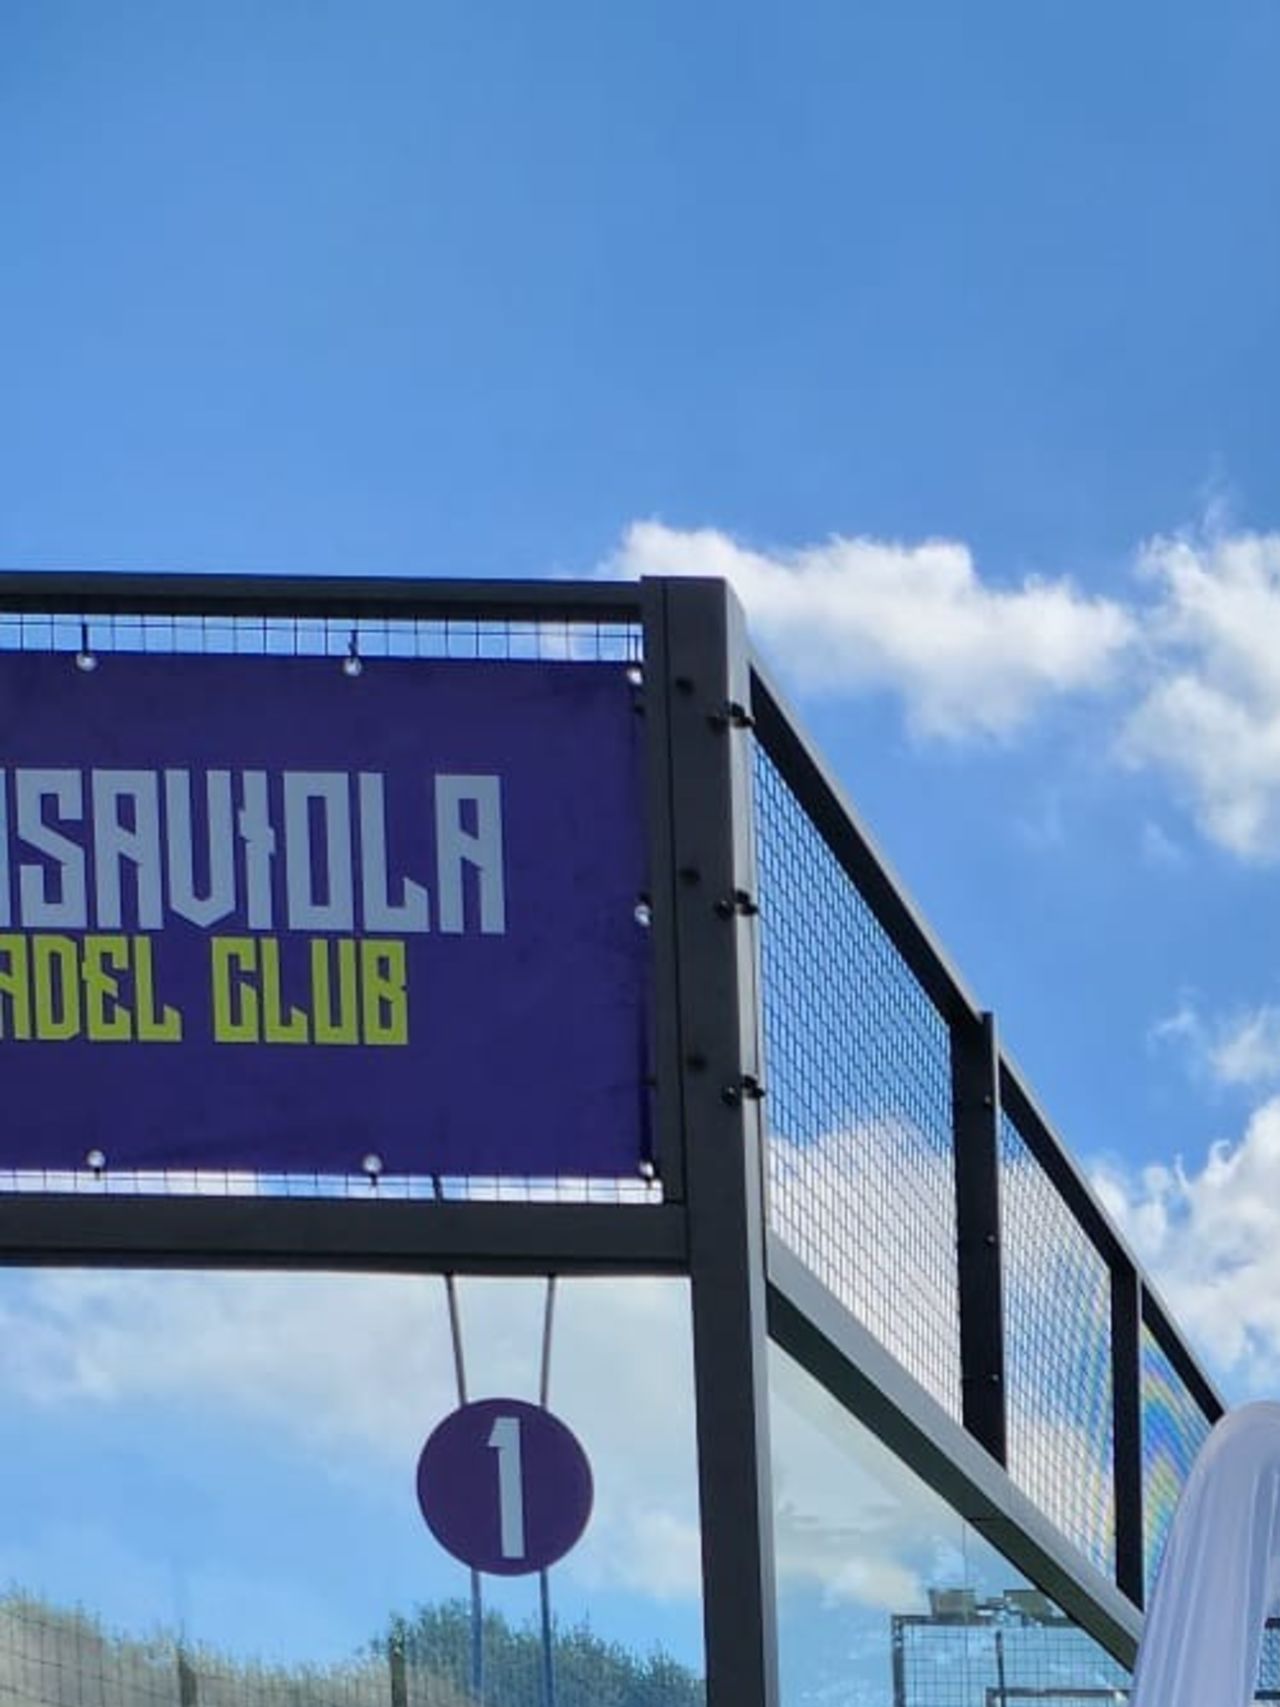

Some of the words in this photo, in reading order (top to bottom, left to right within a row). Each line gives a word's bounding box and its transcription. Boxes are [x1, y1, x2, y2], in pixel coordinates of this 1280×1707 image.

[0, 767, 505, 934] SAVIOLA
[211, 936, 409, 1046] CLUB
[488, 1416, 525, 1559] 1
